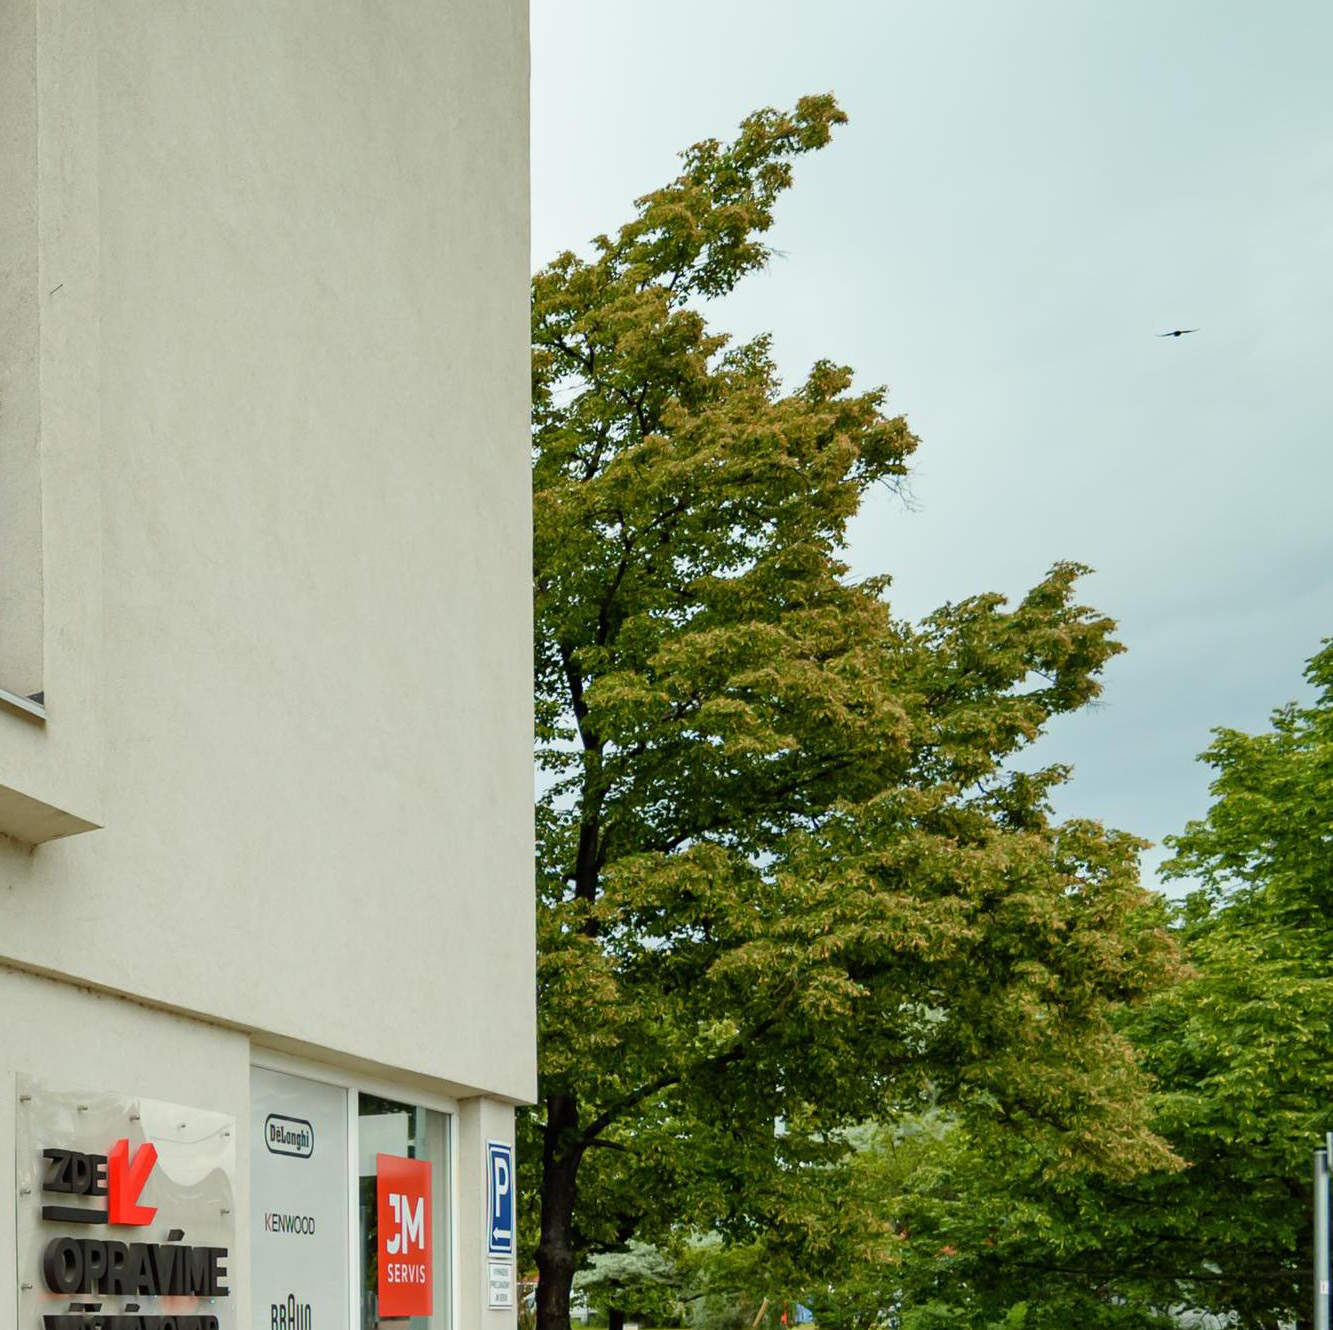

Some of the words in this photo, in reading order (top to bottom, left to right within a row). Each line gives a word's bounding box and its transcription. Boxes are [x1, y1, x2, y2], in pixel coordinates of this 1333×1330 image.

[43, 1148, 108, 1196] ZDE
[494, 1156, 509, 1218] P
[264, 1212, 316, 1235] KENWOOD
[386, 1193, 425, 1254] JM
[44, 1229, 229, 1297] OPRAVÍME
[387, 1263, 426, 1284] SERVIS
